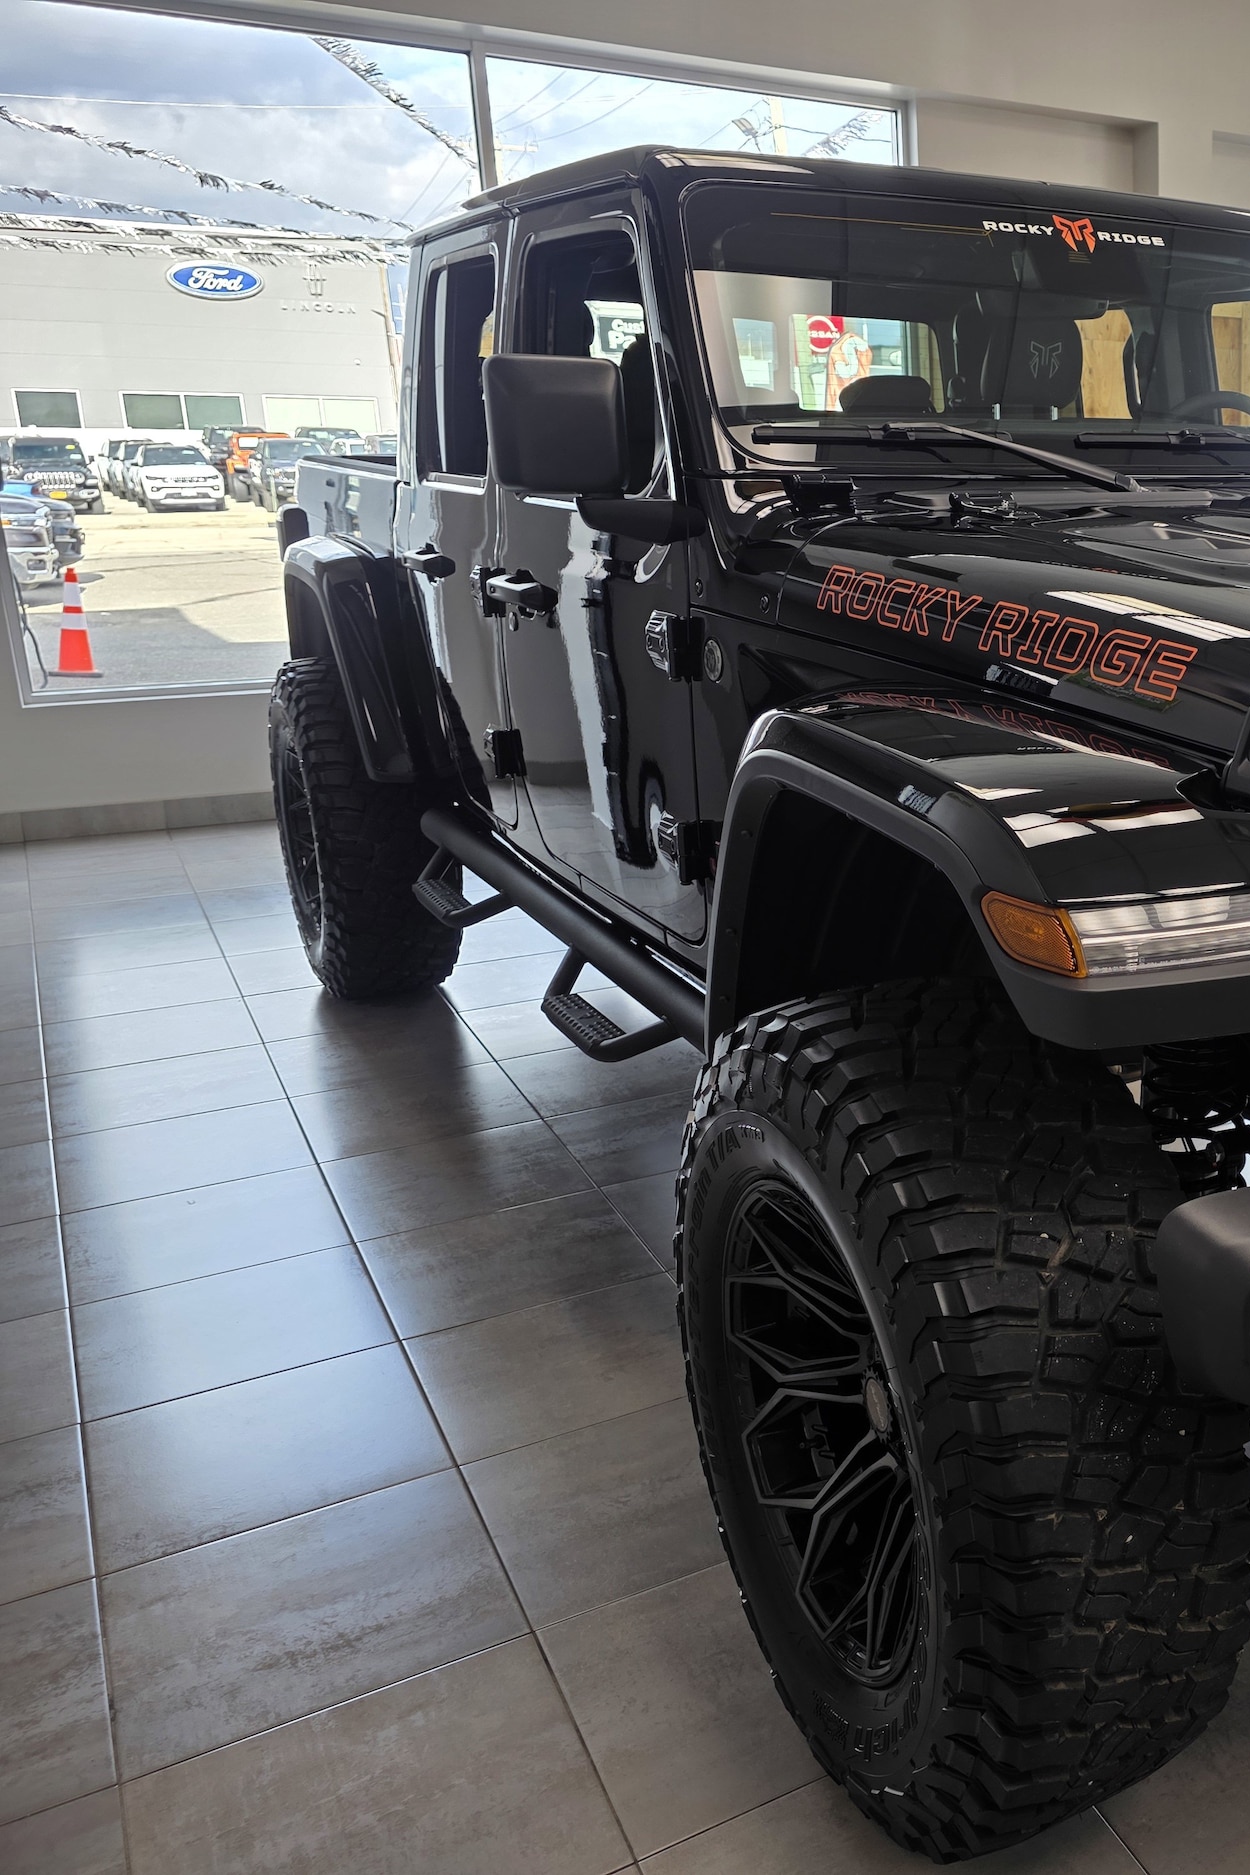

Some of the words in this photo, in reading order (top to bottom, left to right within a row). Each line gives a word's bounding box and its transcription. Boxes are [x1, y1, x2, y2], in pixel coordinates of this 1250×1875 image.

[982, 220, 1055, 236] ROCKY
[1097, 231, 1166, 247] RIDGE
[187, 267, 244, 292] Ford
[816, 563, 983, 643] ROCKY
[977, 600, 1199, 701] RIDGE
